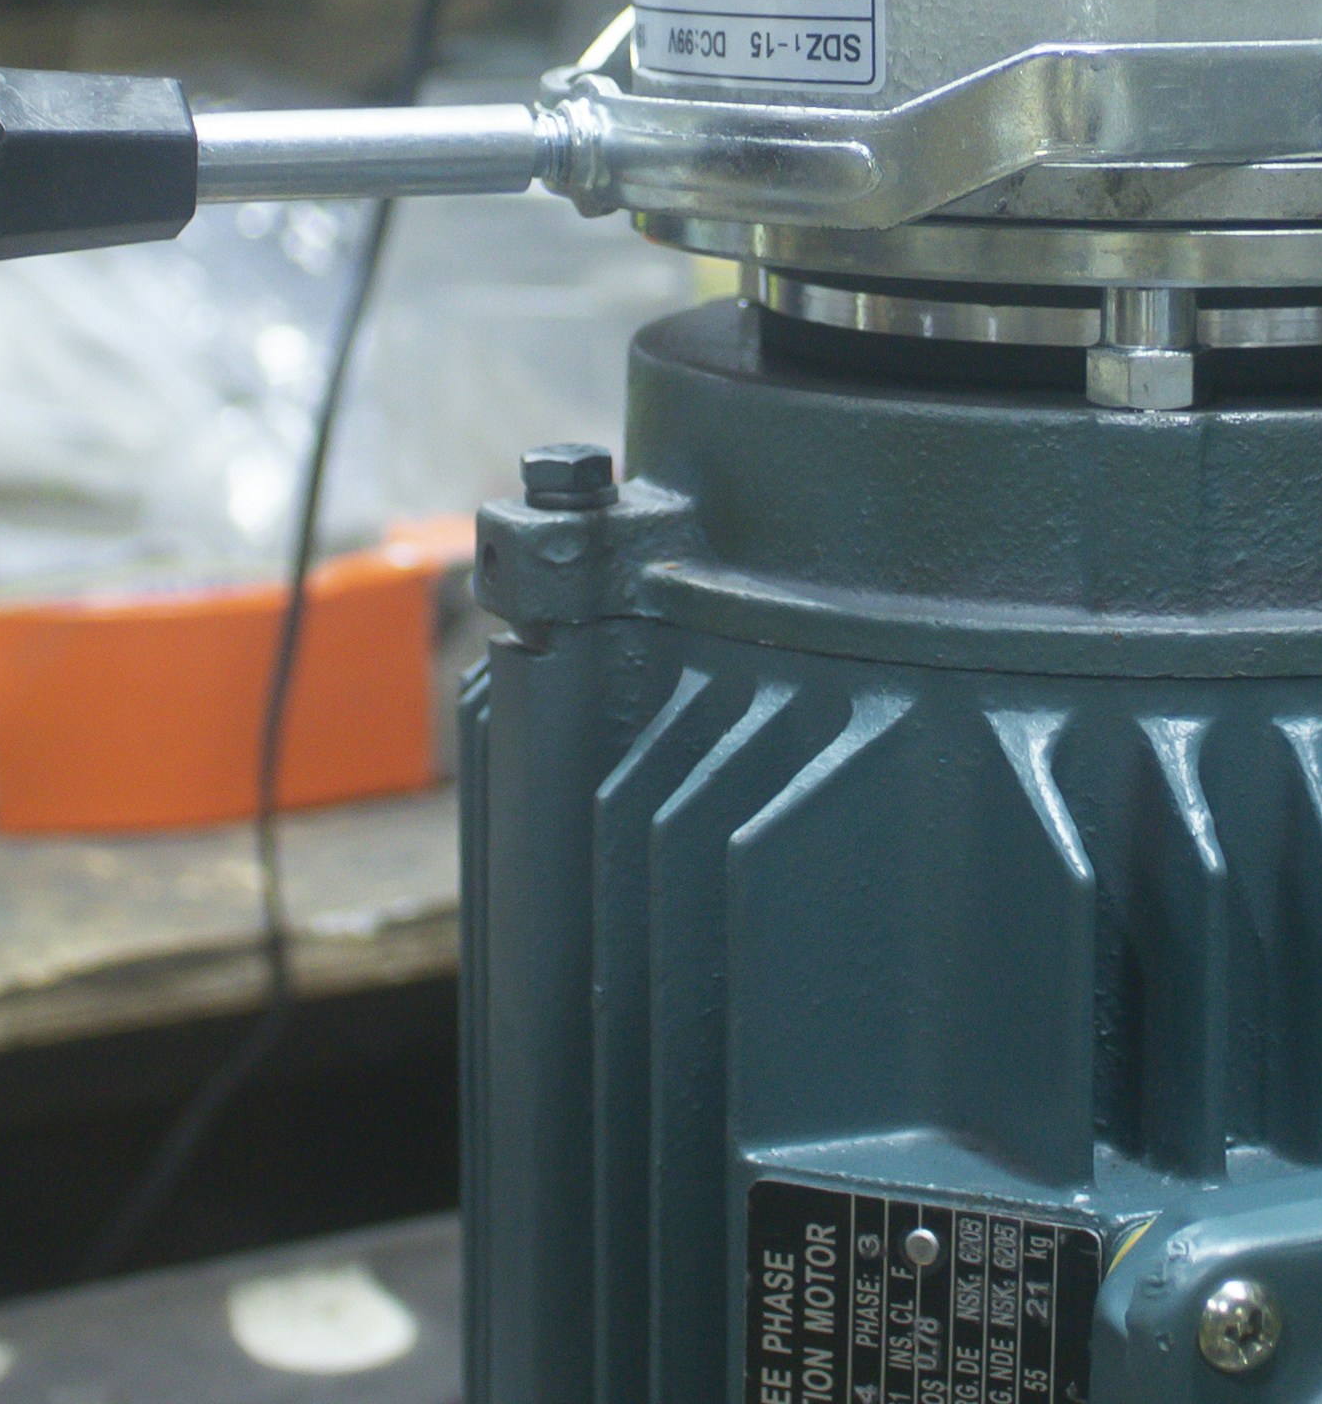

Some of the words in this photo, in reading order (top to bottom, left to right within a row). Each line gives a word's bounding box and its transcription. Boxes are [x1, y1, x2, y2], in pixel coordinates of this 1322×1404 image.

[668, 27, 726, 57] DC:99V
[857, 1233, 880, 1258] 3
[993, 1223, 1017, 1270] 6205
[1024, 1236, 1054, 1260] kg
[803, 1223, 836, 1334] MOTOR
[890, 1266, 914, 1280] F
[762, 1250, 794, 1354] PHASE
[855, 1274, 880, 1348] PHASE:
[890, 1300, 914, 1324] CL
[1026, 1280, 1051, 1320] 21
[913, 1317, 940, 1371] 0.78
[956, 1346, 980, 1375] DE
[990, 1338, 1014, 1381] NDE
[1024, 1368, 1048, 1392] 55
